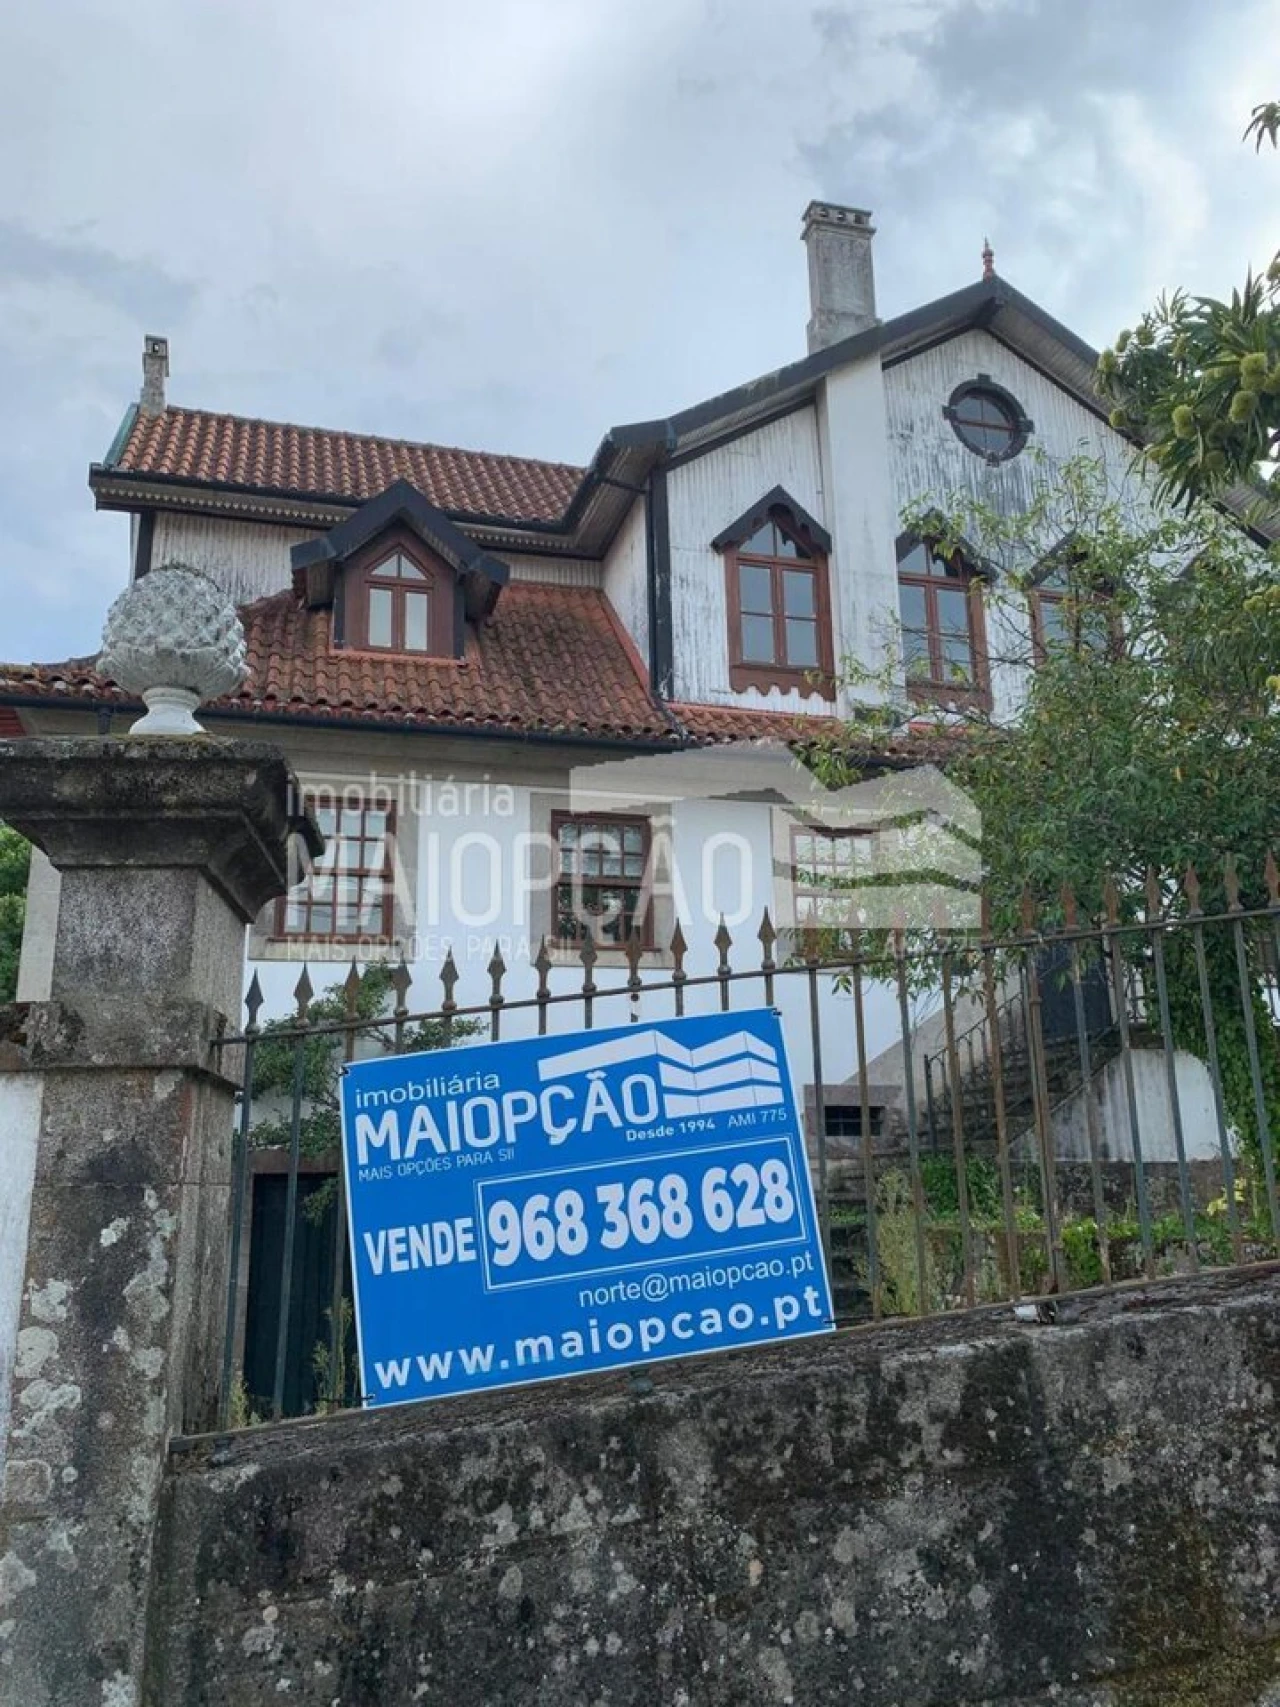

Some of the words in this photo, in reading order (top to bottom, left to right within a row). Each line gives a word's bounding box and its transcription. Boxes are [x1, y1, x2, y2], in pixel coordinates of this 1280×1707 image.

[354, 1070, 659, 1166] MAIOPÇÃO
[355, 1071, 501, 1108] imobiliária
[625, 1126, 675, 1141] Desde
[679, 1120, 716, 1134] 1994
[727, 1114, 756, 1129] AMI
[761, 1108, 787, 1123] 775
[358, 1164, 393, 1182] MAIS
[397, 1155, 452, 1176] OPÇÕES
[456, 1151, 493, 1167] PARA
[488, 1189, 589, 1267] 968
[596, 1174, 693, 1249] 368
[701, 1159, 794, 1233] 628
[363, 1217, 477, 1276] VENDE
[579, 1252, 814, 1308] norte@maiopcao.pt
[374, 1285, 822, 1389] www.maiopcao.pt
